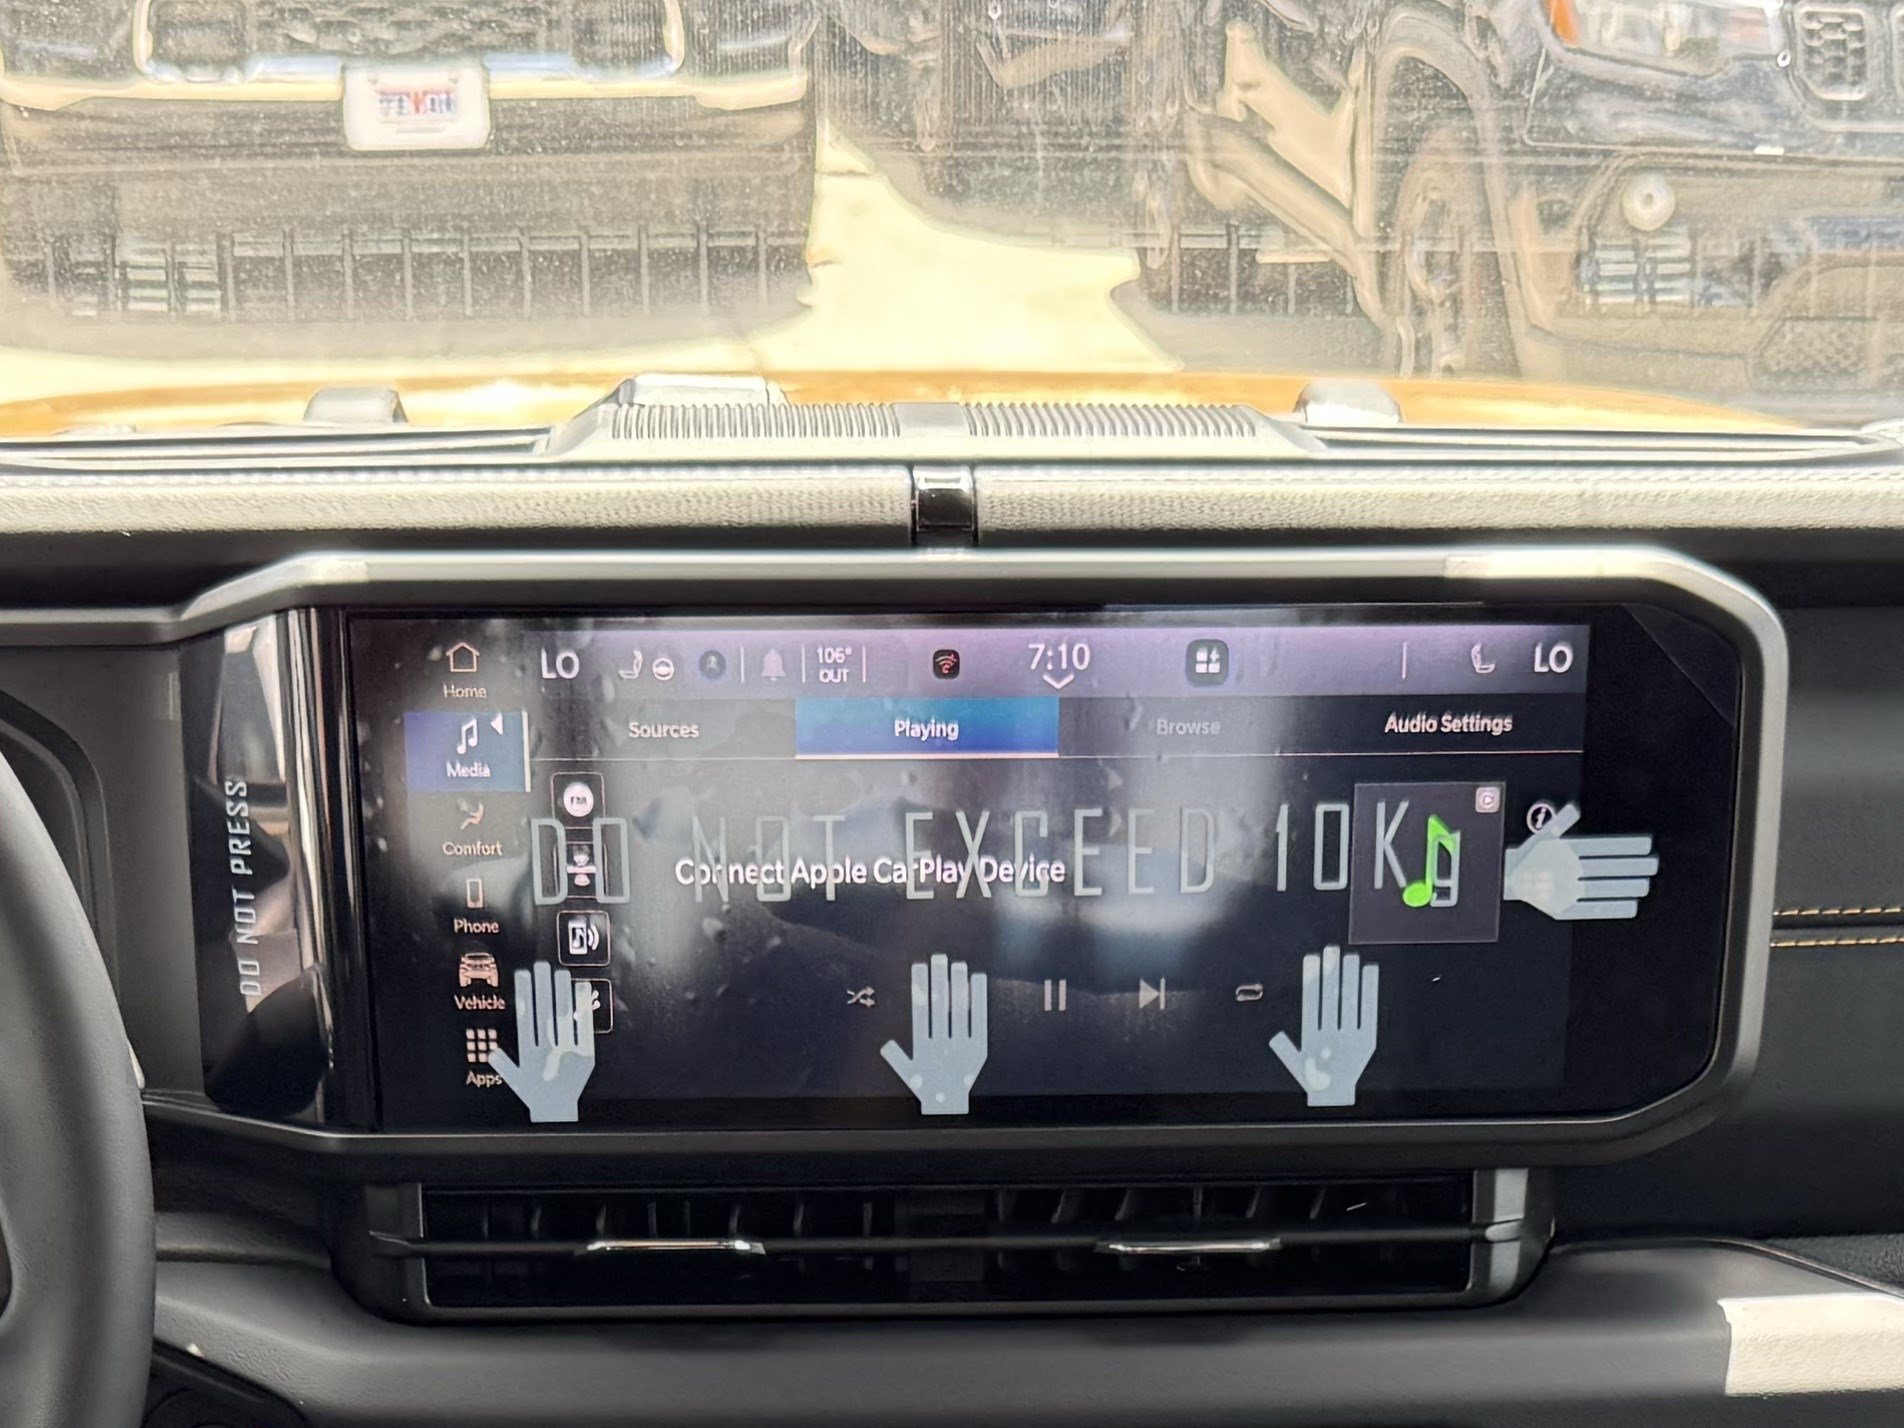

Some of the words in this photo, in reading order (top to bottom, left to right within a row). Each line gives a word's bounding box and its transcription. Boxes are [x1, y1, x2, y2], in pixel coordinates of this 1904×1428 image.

[541, 648, 580, 680] LO
[1027, 642, 1091, 671] 7:10
[1533, 643, 1574, 674] LO
[817, 666, 850, 683] OUT
[443, 684, 488, 699] Home
[628, 720, 700, 739] Sources
[894, 717, 960, 741] Playing
[1156, 717, 1222, 736] Browse
[1384, 711, 1438, 734] Audio
[1440, 711, 1514, 736] Settings
[446, 762, 491, 778] Media
[224, 779, 254, 877] PRESS
[442, 840, 503, 857] Comfort
[530, 816, 631, 907] DO
[691, 813, 847, 903] NOT
[905, 804, 1217, 902] EXCEED
[674, 856, 786, 887] Connect
[791, 856, 868, 890] Apple
[872, 856, 969, 888] CarPlay
[981, 856, 1066, 884] Device
[230, 887, 260, 947] NOT
[454, 918, 500, 935] Phone
[239, 954, 263, 998] DO
[454, 994, 506, 1011] Vehicle
[466, 1070, 504, 1088] Apps
